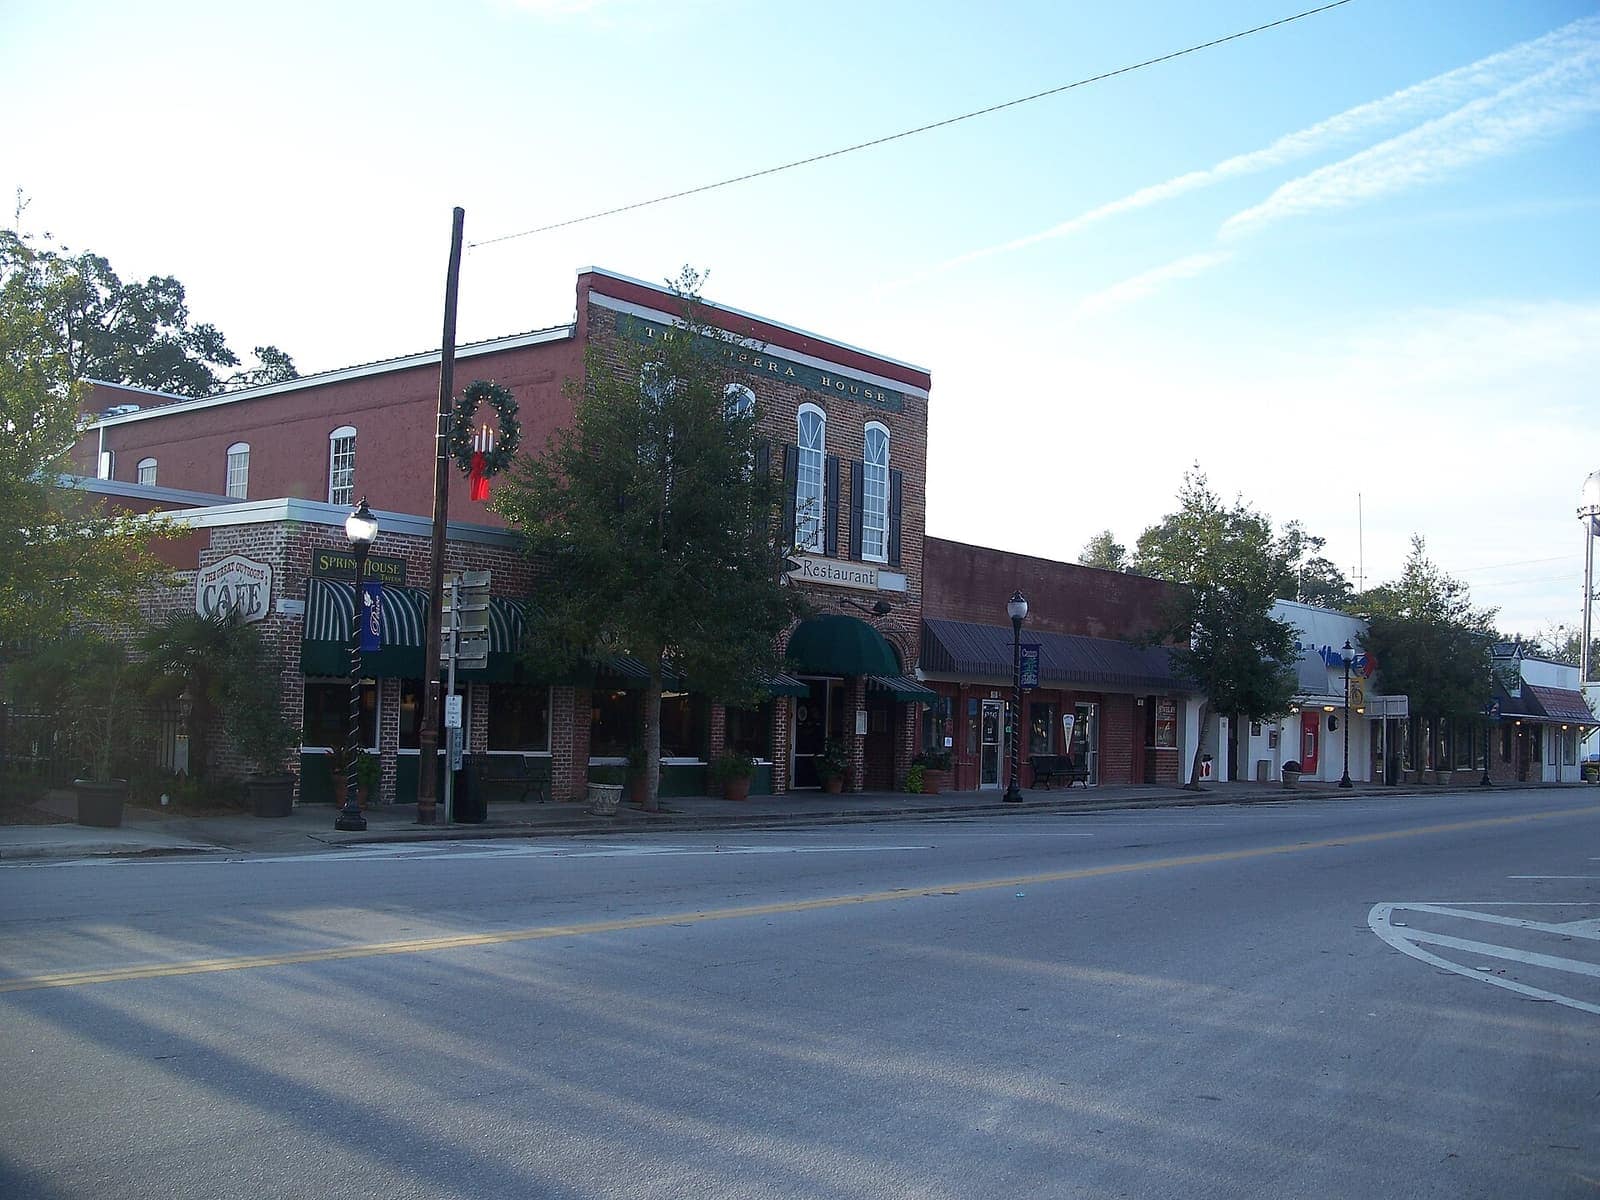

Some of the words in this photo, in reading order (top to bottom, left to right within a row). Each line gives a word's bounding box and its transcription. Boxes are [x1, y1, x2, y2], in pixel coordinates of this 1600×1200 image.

[820, 375, 887, 402] HOUSE
[204, 570, 217, 583] THE
[216, 561, 235, 579] GREAT
[235, 562, 265, 580] OUTDOORS
[319, 555, 357, 571] SPRIN
[803, 560, 875, 585] Restaurant
[202, 582, 262, 618] CAFE
